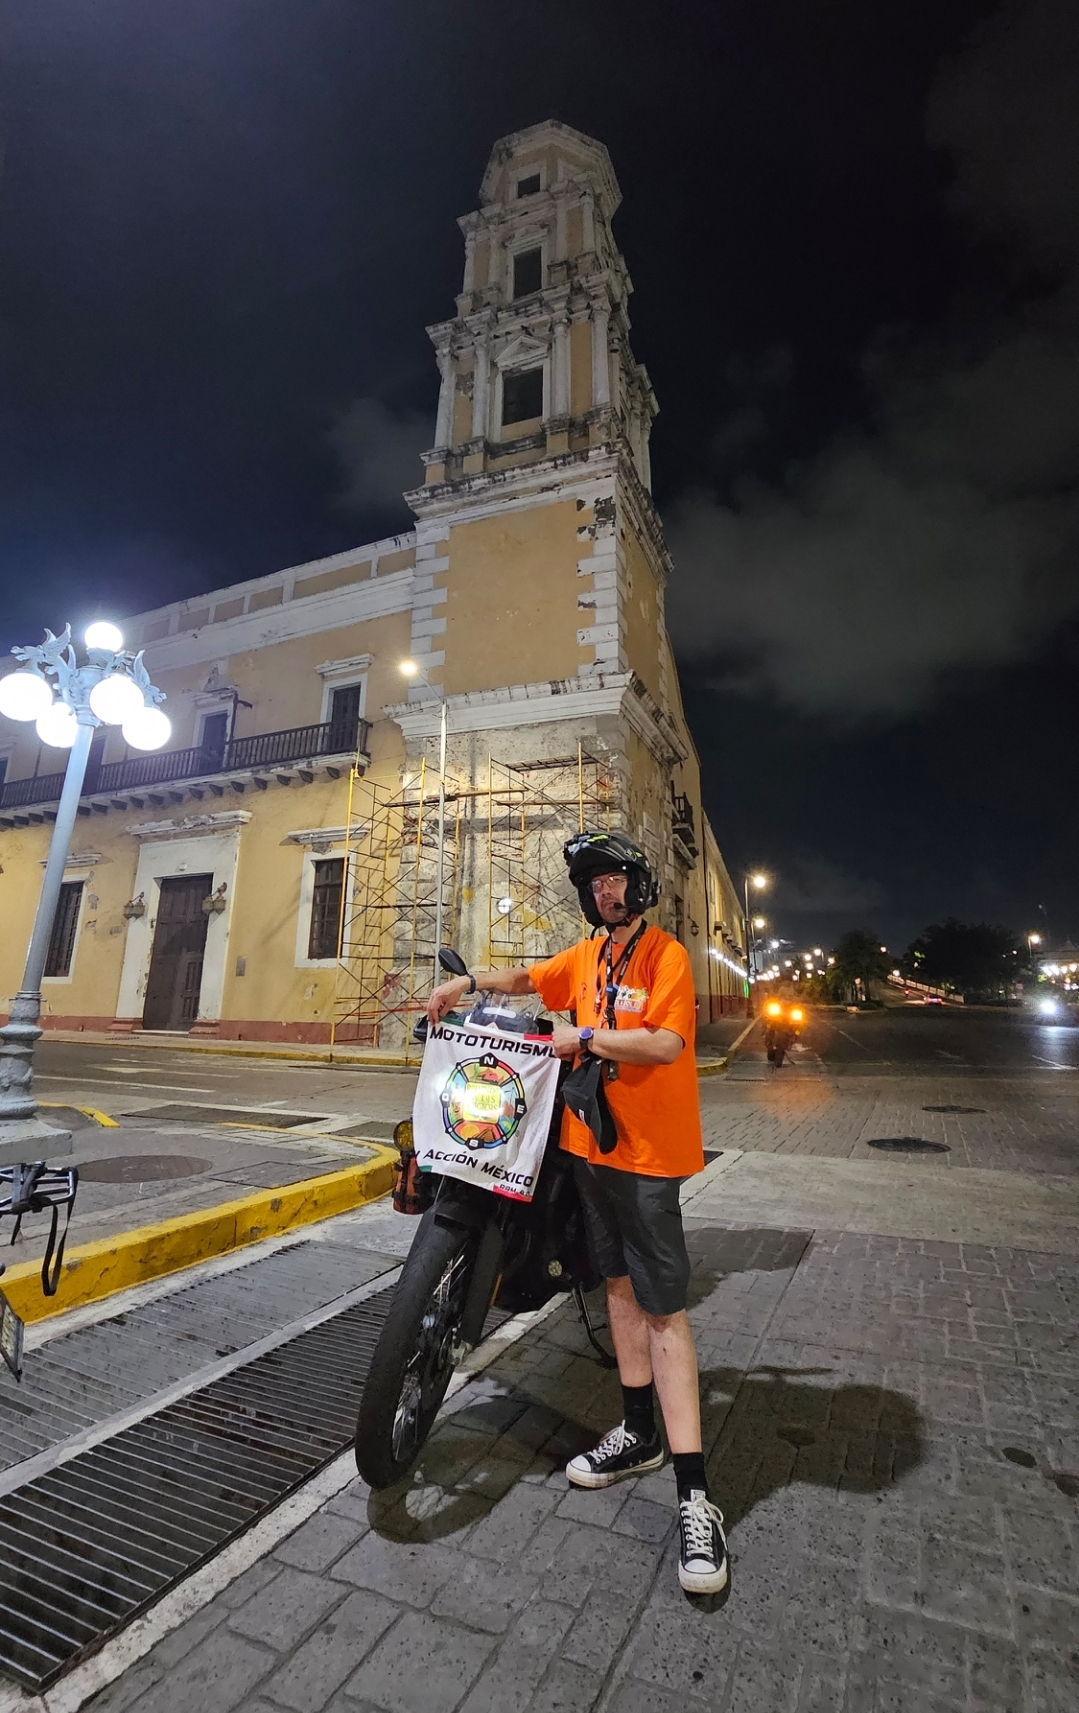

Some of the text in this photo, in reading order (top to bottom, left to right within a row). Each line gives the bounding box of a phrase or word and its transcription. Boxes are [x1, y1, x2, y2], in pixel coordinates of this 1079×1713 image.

[483, 1056, 495, 1066] N
[516, 1104, 525, 1114] E
[423, 1149, 478, 1169] ACCIÓN
[481, 1162, 534, 1188] MÉXICO
